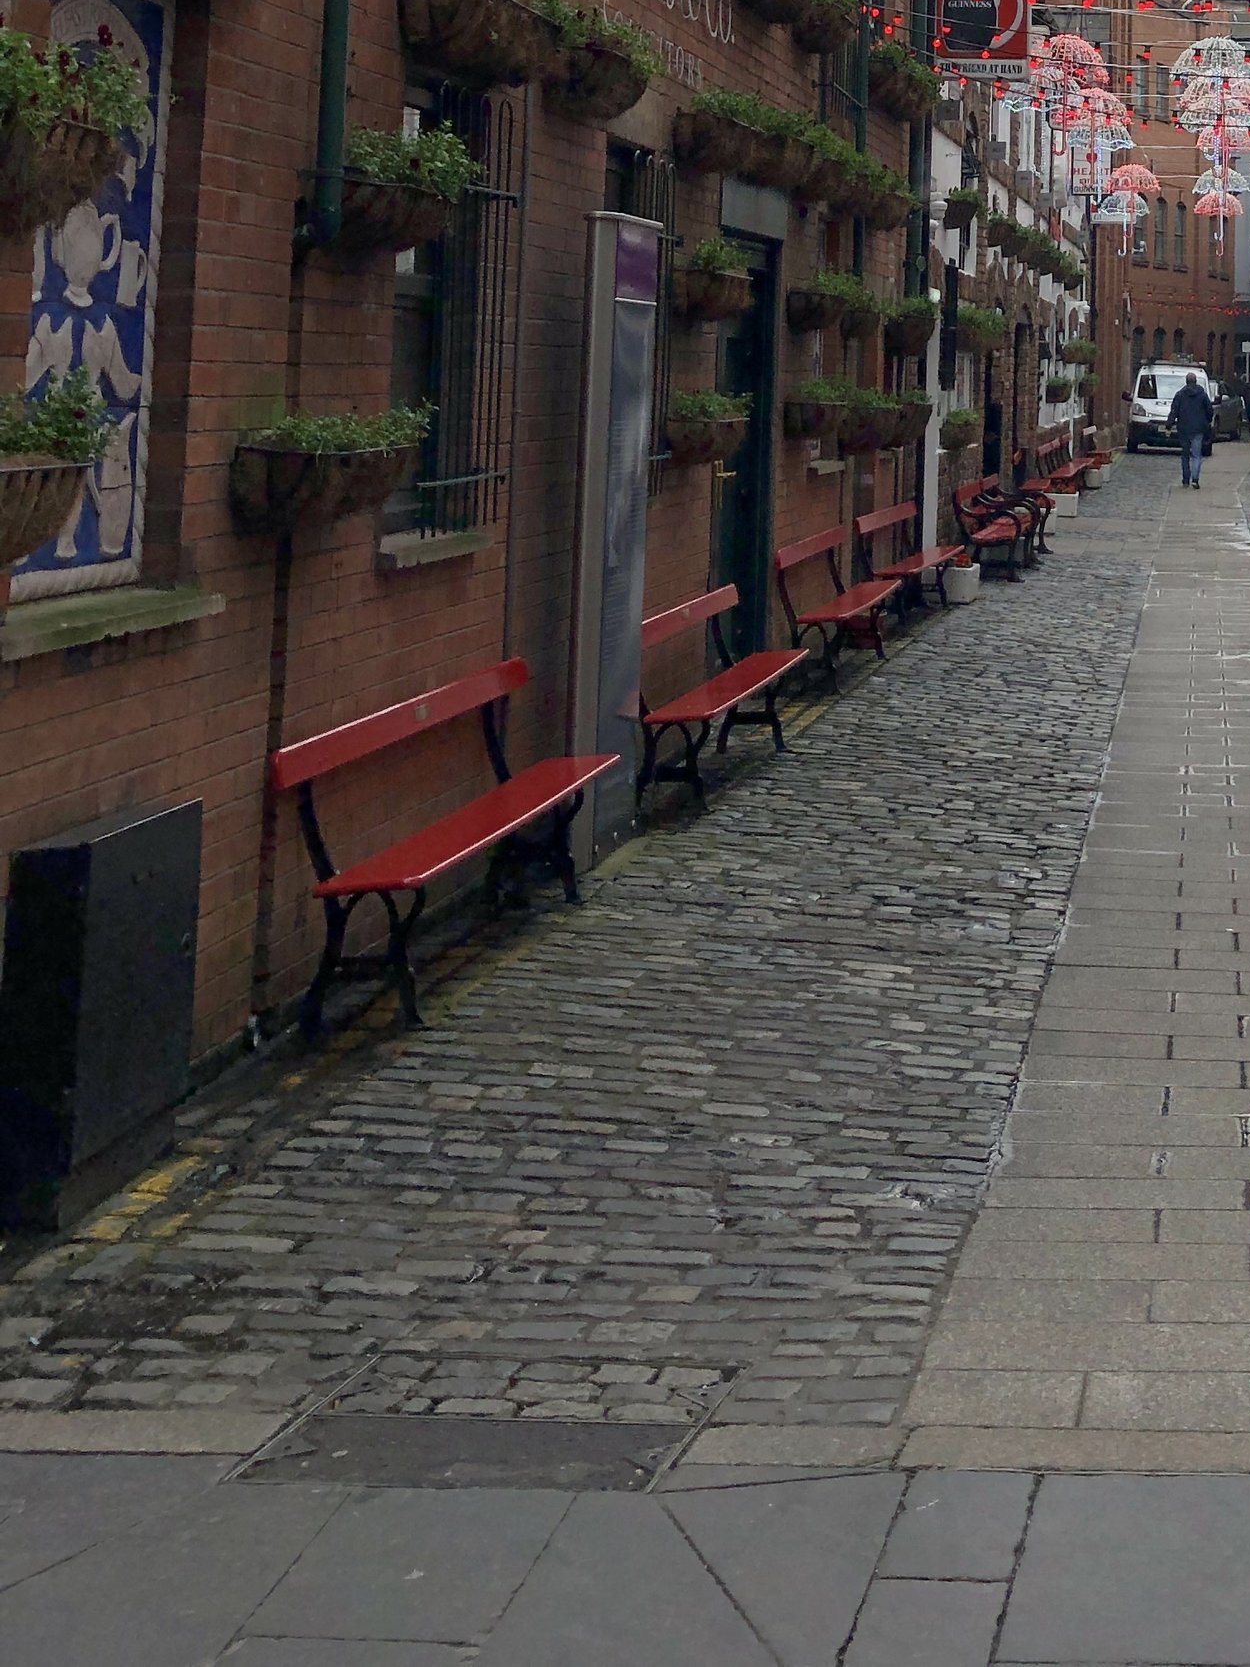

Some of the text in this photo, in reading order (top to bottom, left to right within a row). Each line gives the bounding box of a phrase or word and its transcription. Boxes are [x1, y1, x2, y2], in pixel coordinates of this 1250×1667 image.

[948, 0, 992, 8] GUINNESS
[989, 64, 999, 74] AT
[1000, 64, 1023, 74] HAND
